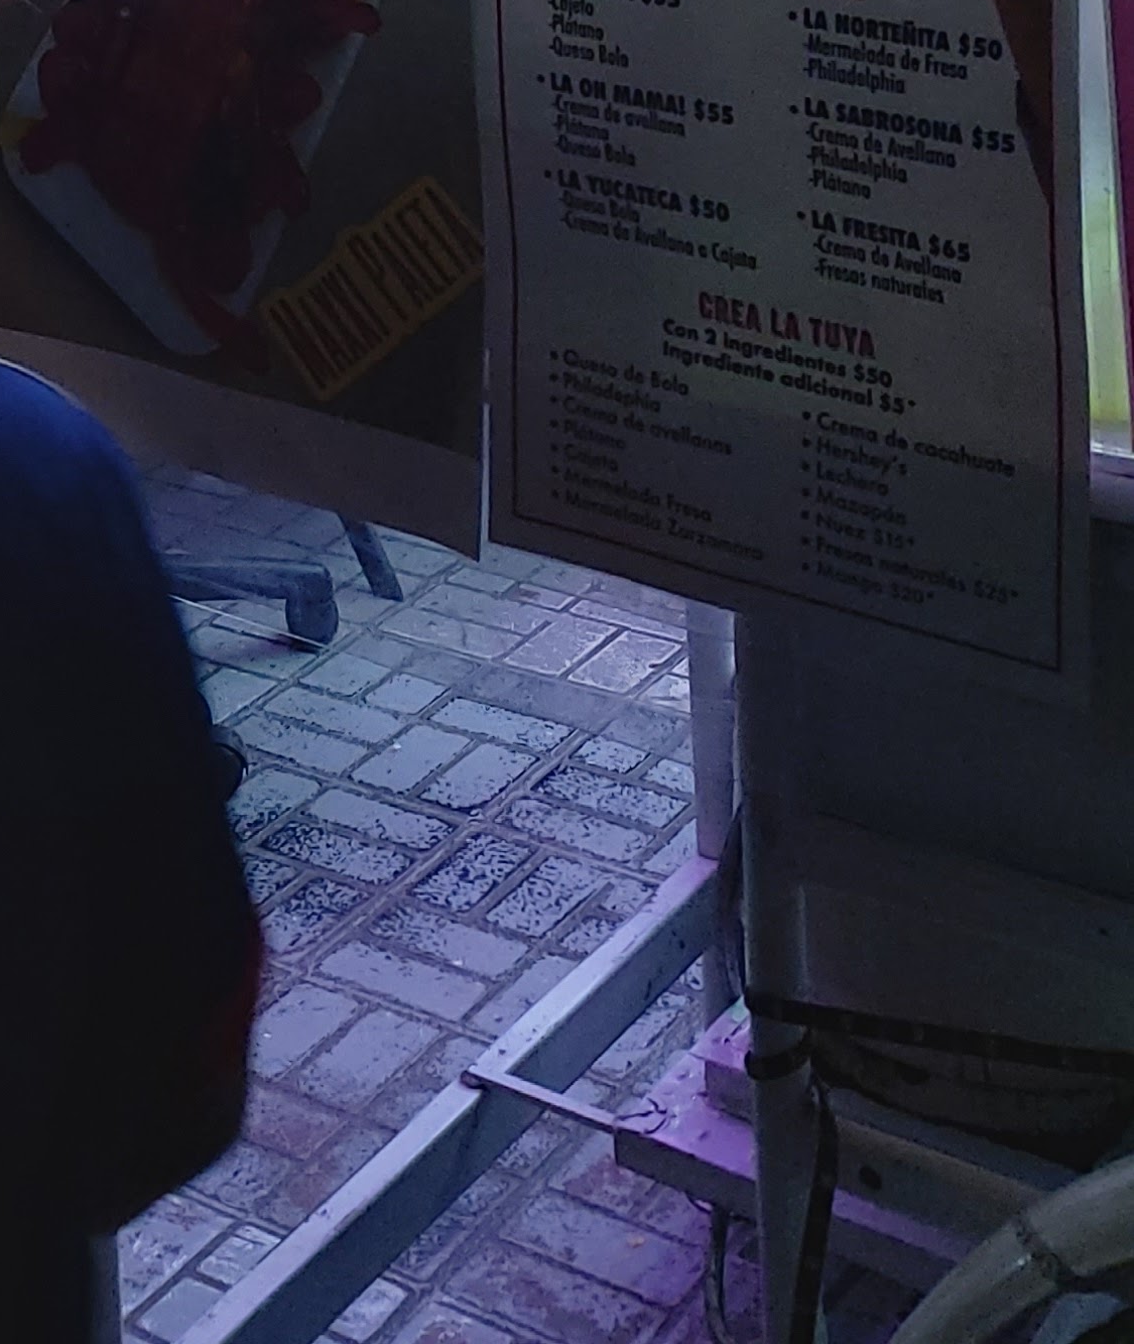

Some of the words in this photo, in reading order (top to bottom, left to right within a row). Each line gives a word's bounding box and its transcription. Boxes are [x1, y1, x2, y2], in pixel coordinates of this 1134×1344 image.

[802, 7, 828, 31] LA
[834, 12, 950, 52] NORTEÑITA
[958, 33, 1003, 61] $50
[899, 49, 920, 72] de
[924, 54, 968, 80] Fresa
[550, 72, 573, 95] LA
[579, 77, 607, 101] OH
[613, 84, 686, 116] MAMA!
[694, 97, 734, 126] $55
[804, 97, 830, 120] LA
[835, 103, 963, 145] SABROSONA
[972, 125, 1016, 154] $55
[863, 132, 882, 154] de
[557, 169, 581, 191] LA
[586, 174, 683, 212] YUCATECA
[689, 194, 730, 222] $50
[811, 210, 836, 233] LA
[842, 216, 921, 252] FRESITA
[928, 234, 971, 262] $65
[871, 245, 890, 268] de
[698, 291, 762, 333] CREA
[770, 308, 802, 343] LA
[808, 316, 876, 360] TUYA
[662, 318, 698, 345] Con
[705, 327, 717, 346] 2
[854, 363, 892, 388] $50
[780, 372, 873, 406] adicional
[816, 412, 878, 443] Crema
[885, 429, 908, 450] de
